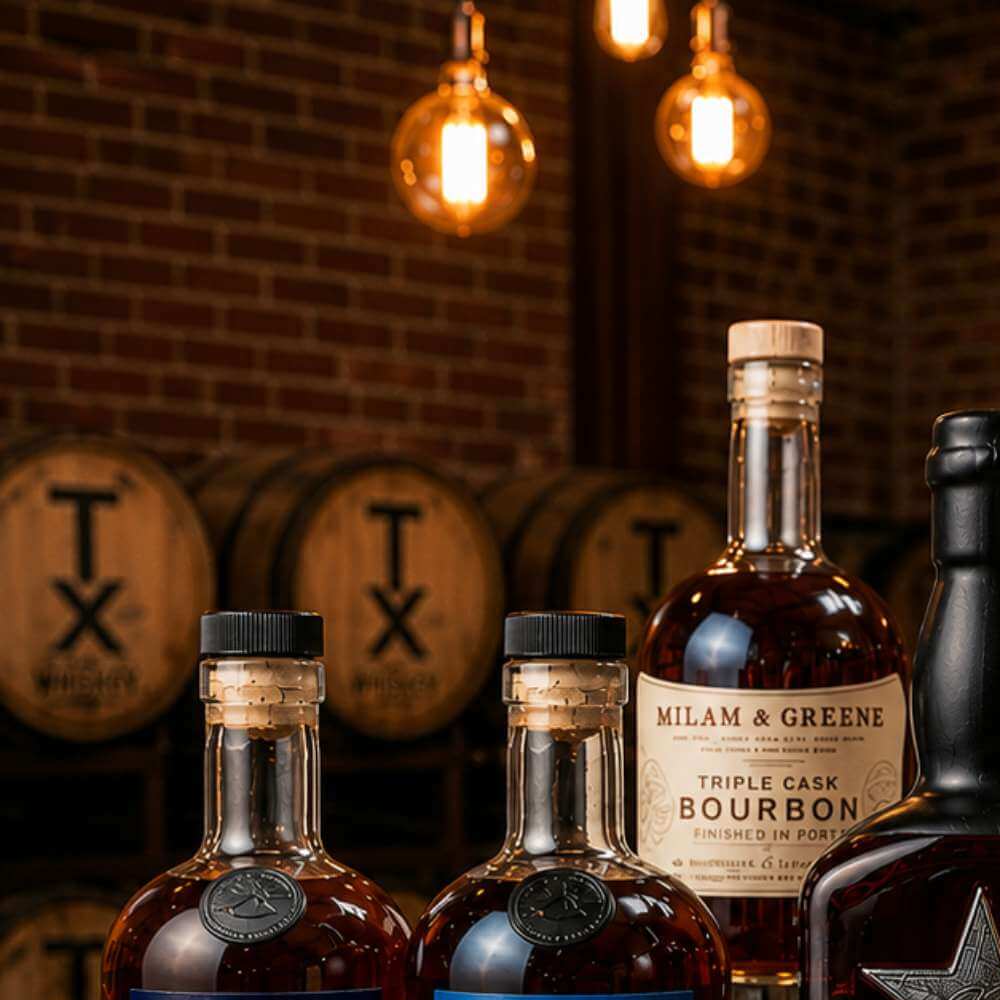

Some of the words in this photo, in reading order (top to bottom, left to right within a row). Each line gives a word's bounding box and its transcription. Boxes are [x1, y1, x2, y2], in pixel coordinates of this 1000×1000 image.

[657, 706, 741, 727] MILAM
[753, 708, 770, 727] &
[780, 706, 884, 728] GREENE
[698, 775, 773, 791] TRIPLE
[783, 775, 839, 791] CASK
[679, 796, 858, 822] BOURBON
[694, 828, 766, 841] FINISHED
[773, 828, 790, 841] IN
